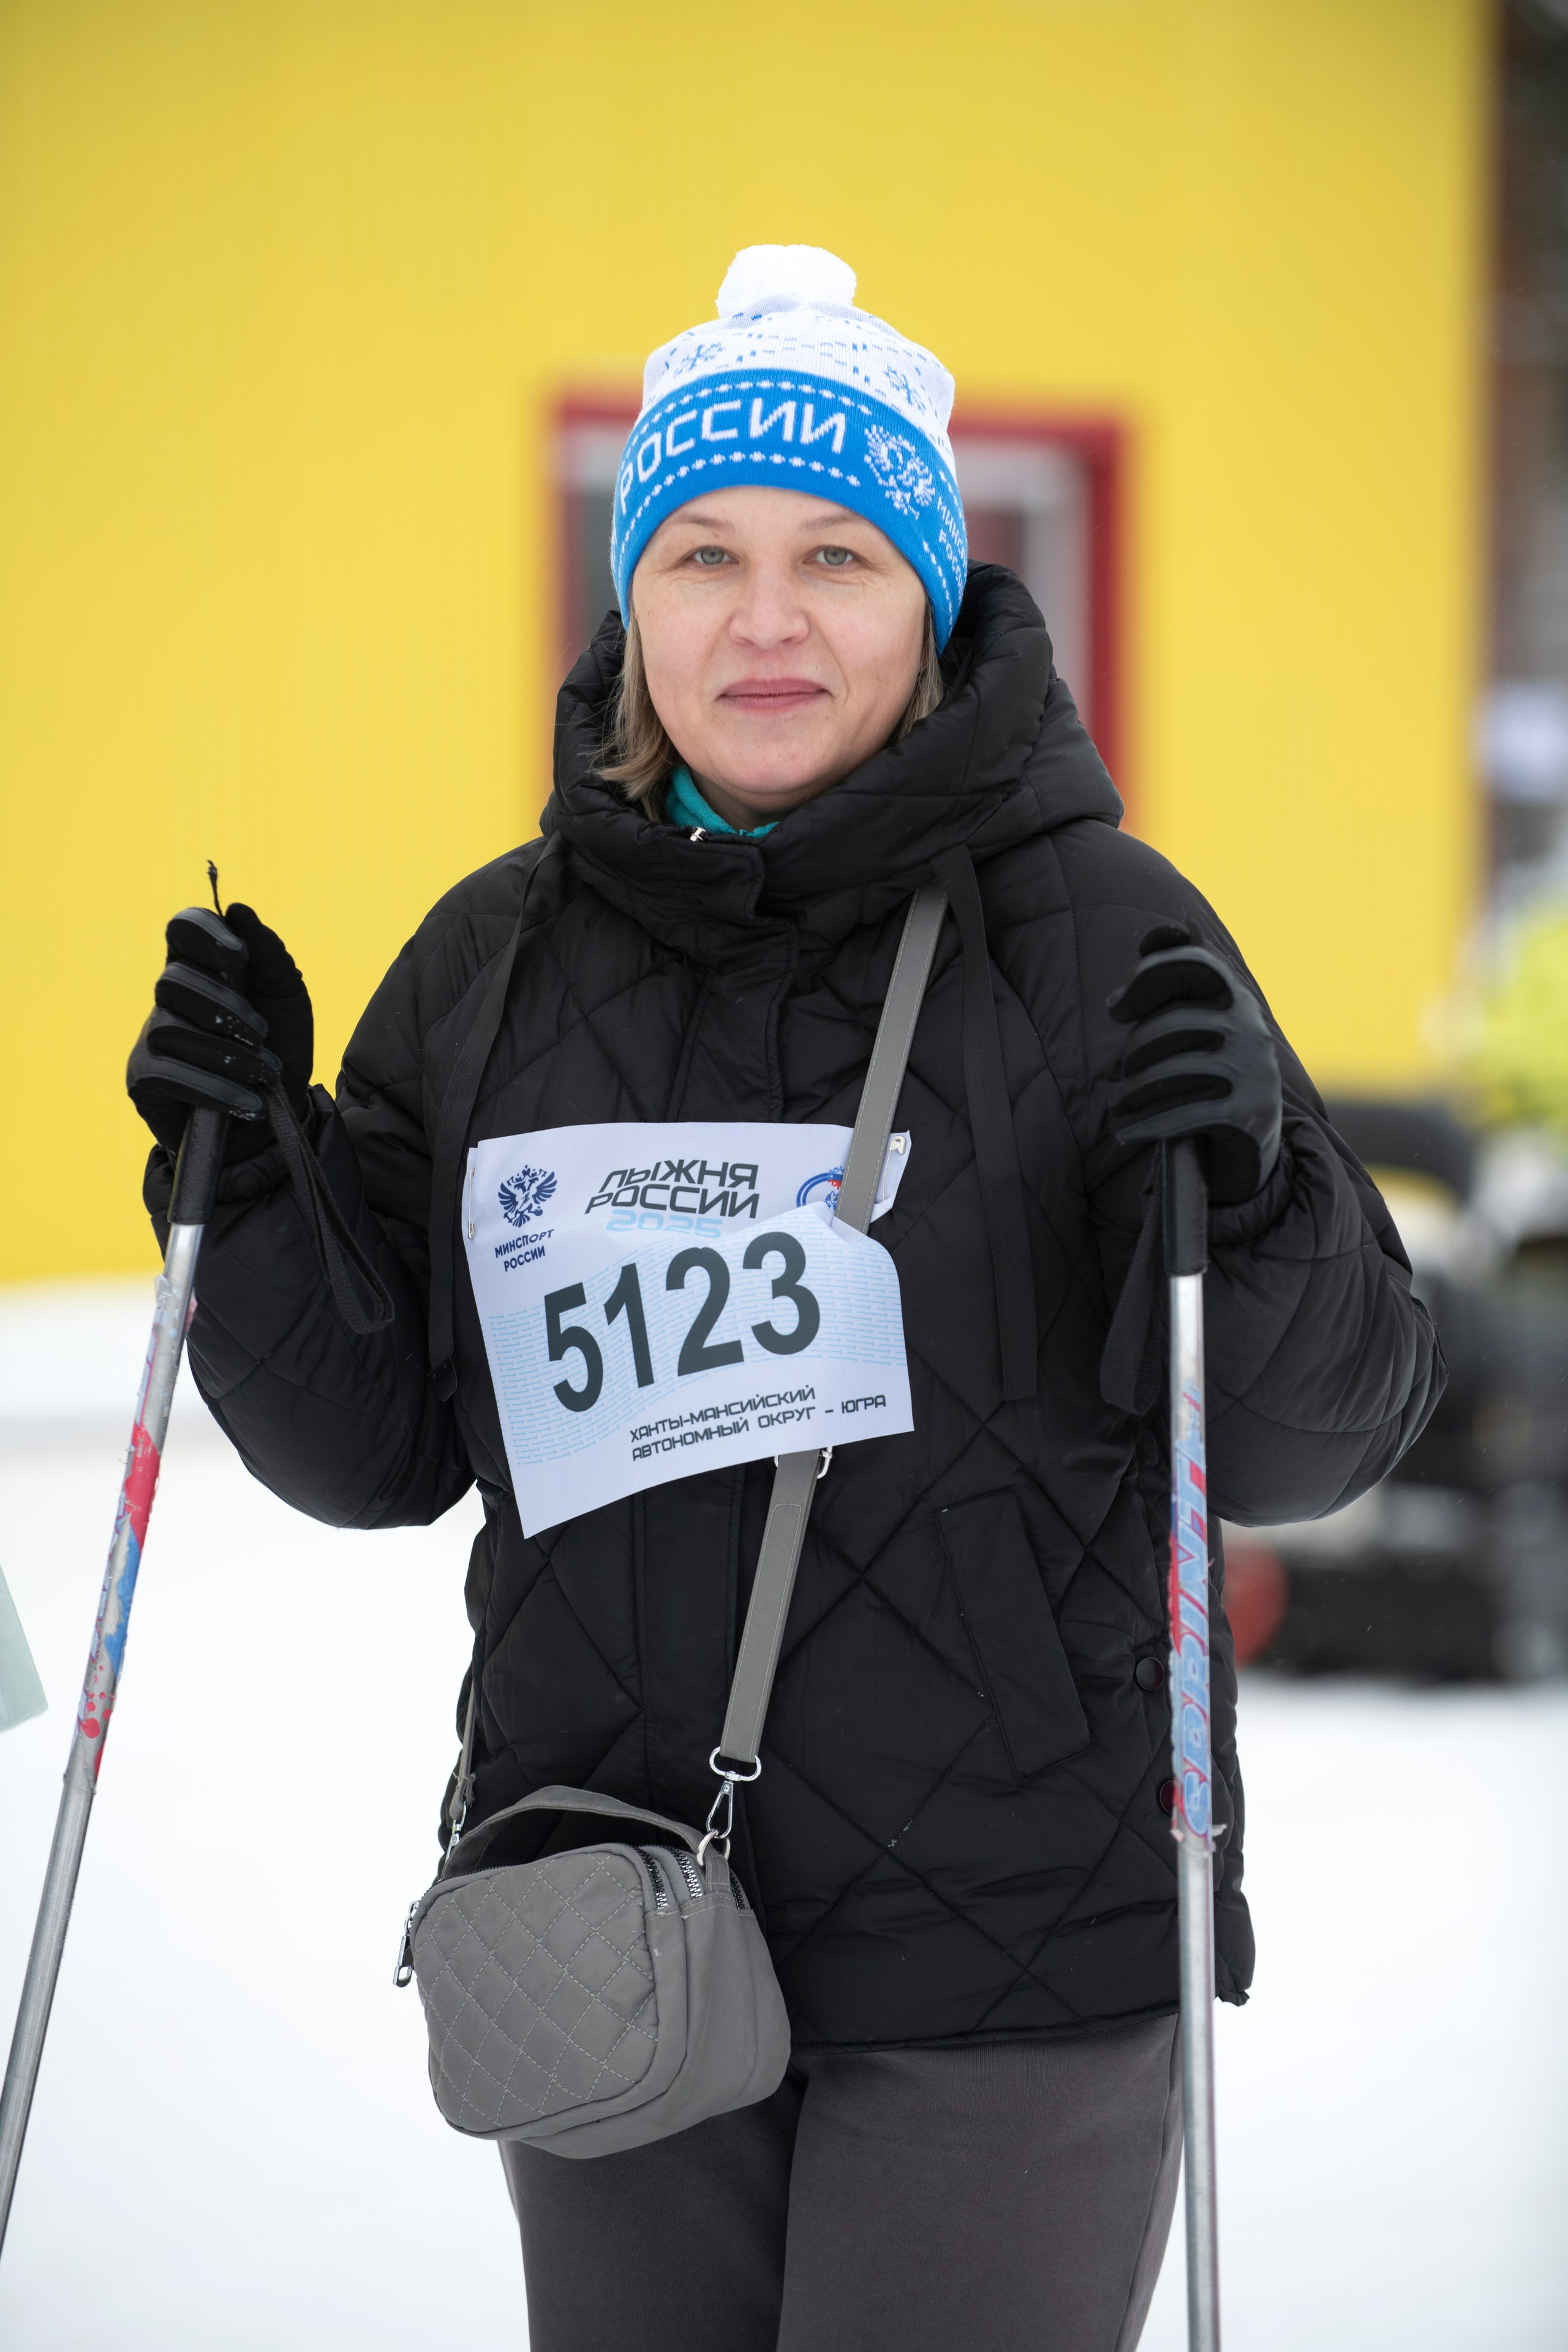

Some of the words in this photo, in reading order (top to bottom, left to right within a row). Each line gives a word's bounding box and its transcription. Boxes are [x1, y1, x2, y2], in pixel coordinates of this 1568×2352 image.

[620, 397, 846, 516] РОССИИ
[598, 1159, 760, 1193] ЛЫЖНЯ
[584, 1183, 760, 1219] РОССИИ
[606, 1209, 723, 1239] 2025
[494, 1229, 554, 1259] МИНСПОРТ
[503, 1245, 546, 1272] РОССИИ
[544, 1231, 820, 1412] 5123
[630, 1384, 816, 1443] ХАНТЫ-МАНСИЙСКИЙ
[632, 1417, 749, 1461] АВТОНОМНЫЙ
[758, 1406, 816, 1429] ОКРУГ
[841, 1394, 886, 1414] ЮГРА
